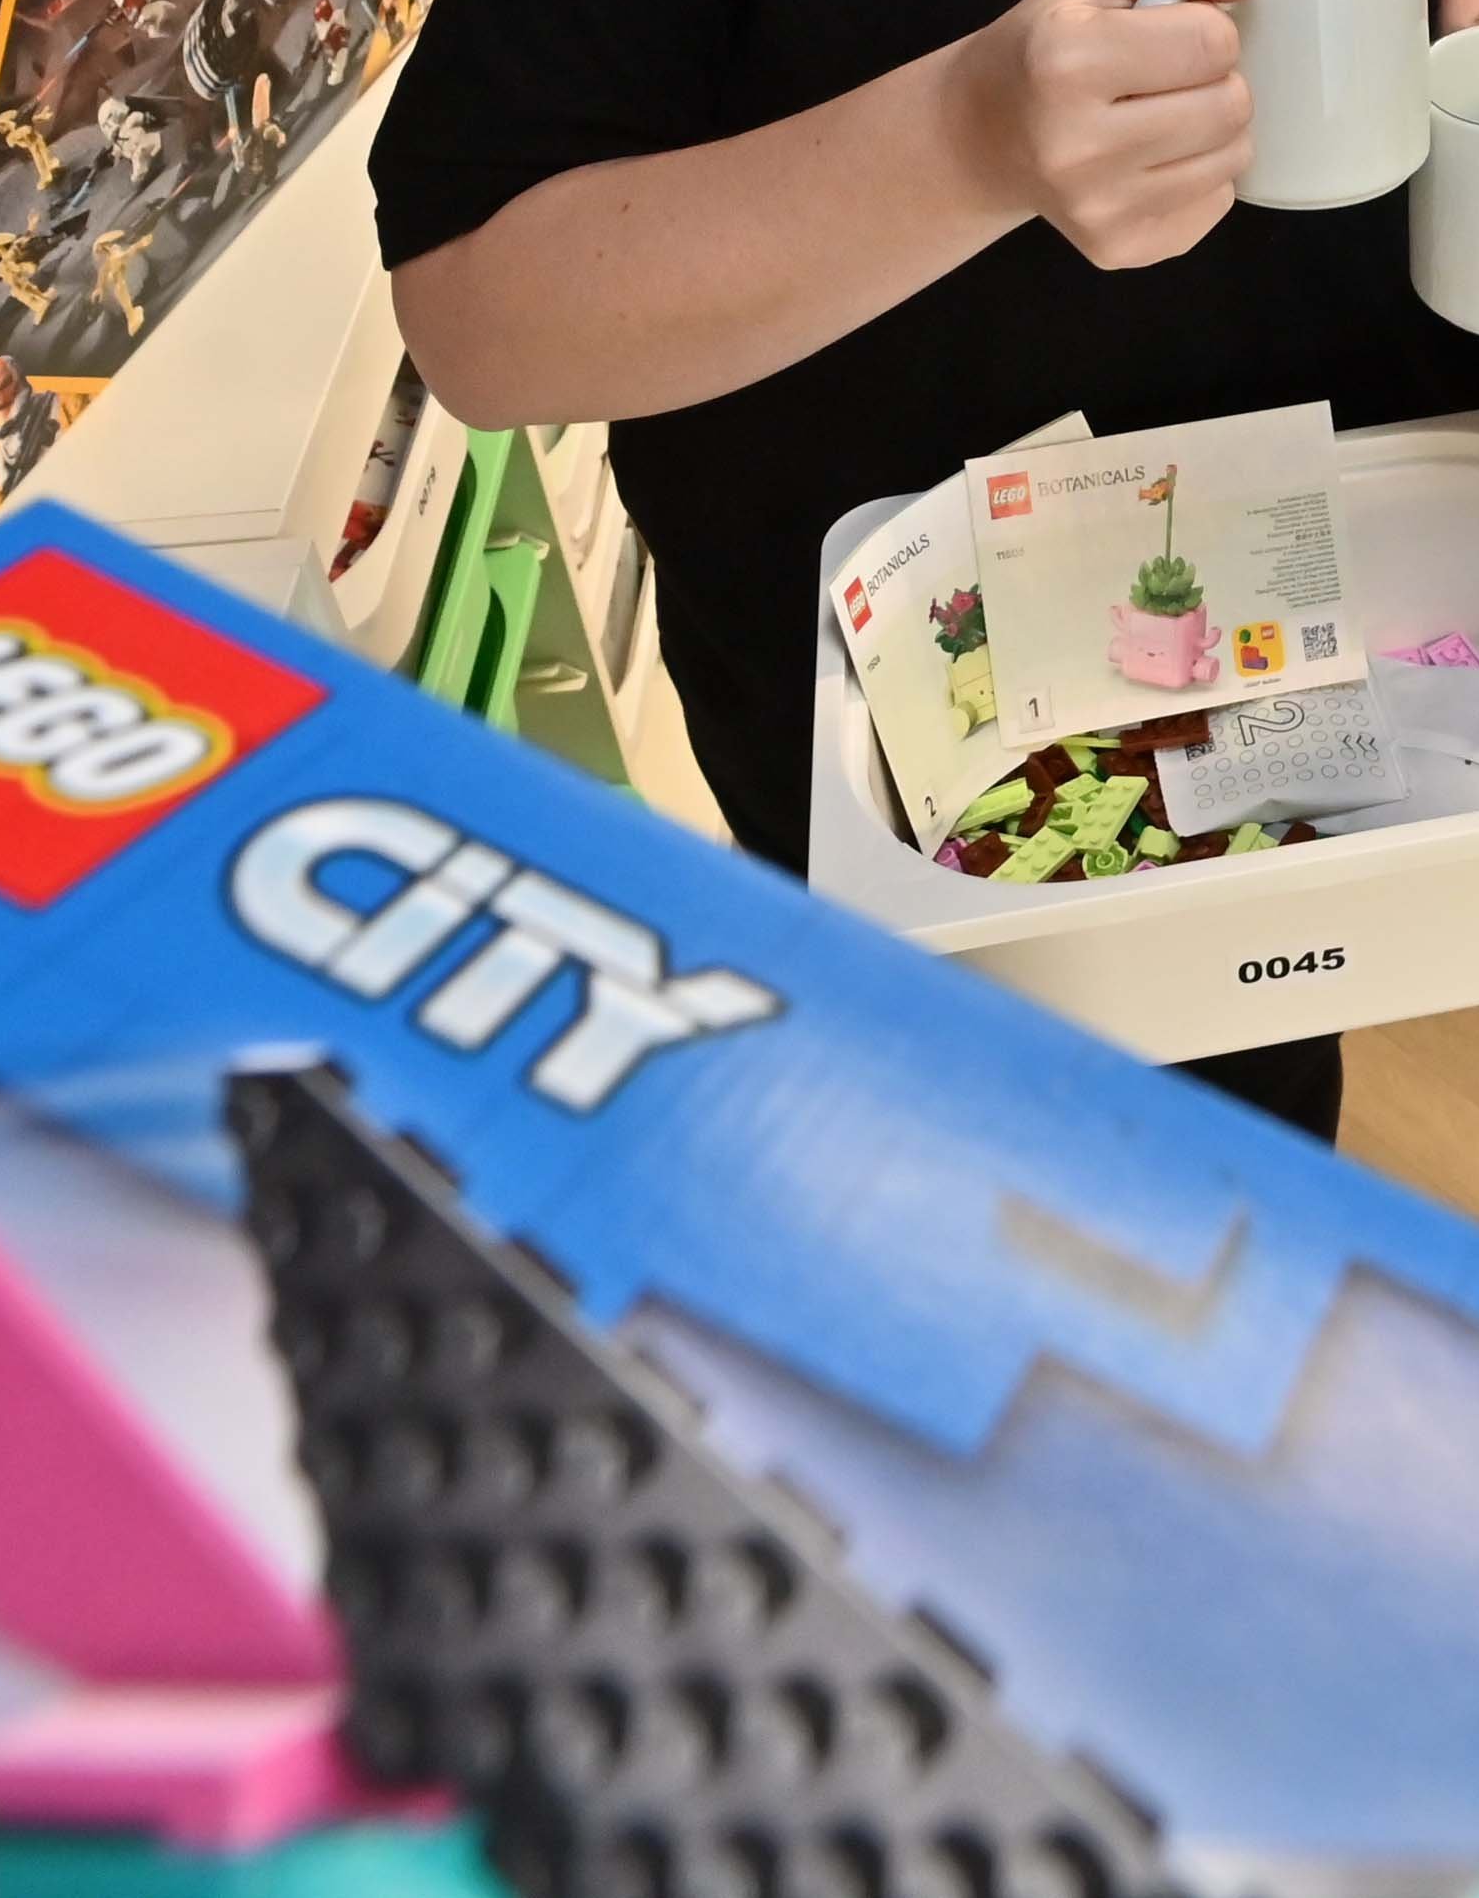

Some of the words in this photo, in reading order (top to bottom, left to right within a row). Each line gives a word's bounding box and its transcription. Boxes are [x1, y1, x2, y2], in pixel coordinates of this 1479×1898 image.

[993, 486, 1027, 507] LEGO
[1037, 464, 1146, 499] BOTANICALS
[866, 533, 931, 599] BOTANICALS
[1029, 697, 1041, 719] 1
[924, 795, 938, 818] 2
[1237, 947, 1347, 985] 0045
